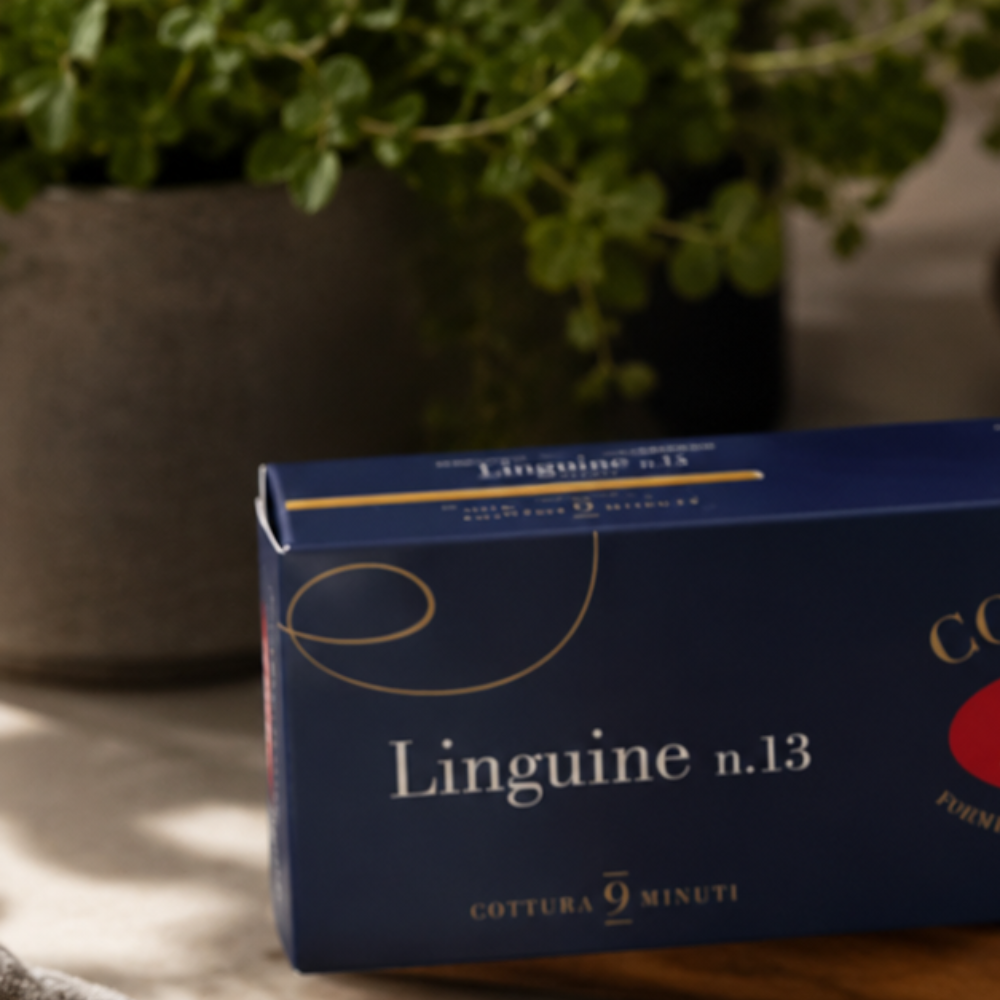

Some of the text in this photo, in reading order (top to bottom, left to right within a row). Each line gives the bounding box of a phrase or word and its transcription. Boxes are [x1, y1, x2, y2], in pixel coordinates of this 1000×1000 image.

[389, 727, 812, 809] Linguine n.13
[469, 880, 739, 921] COTTURA 9 MINUTI
